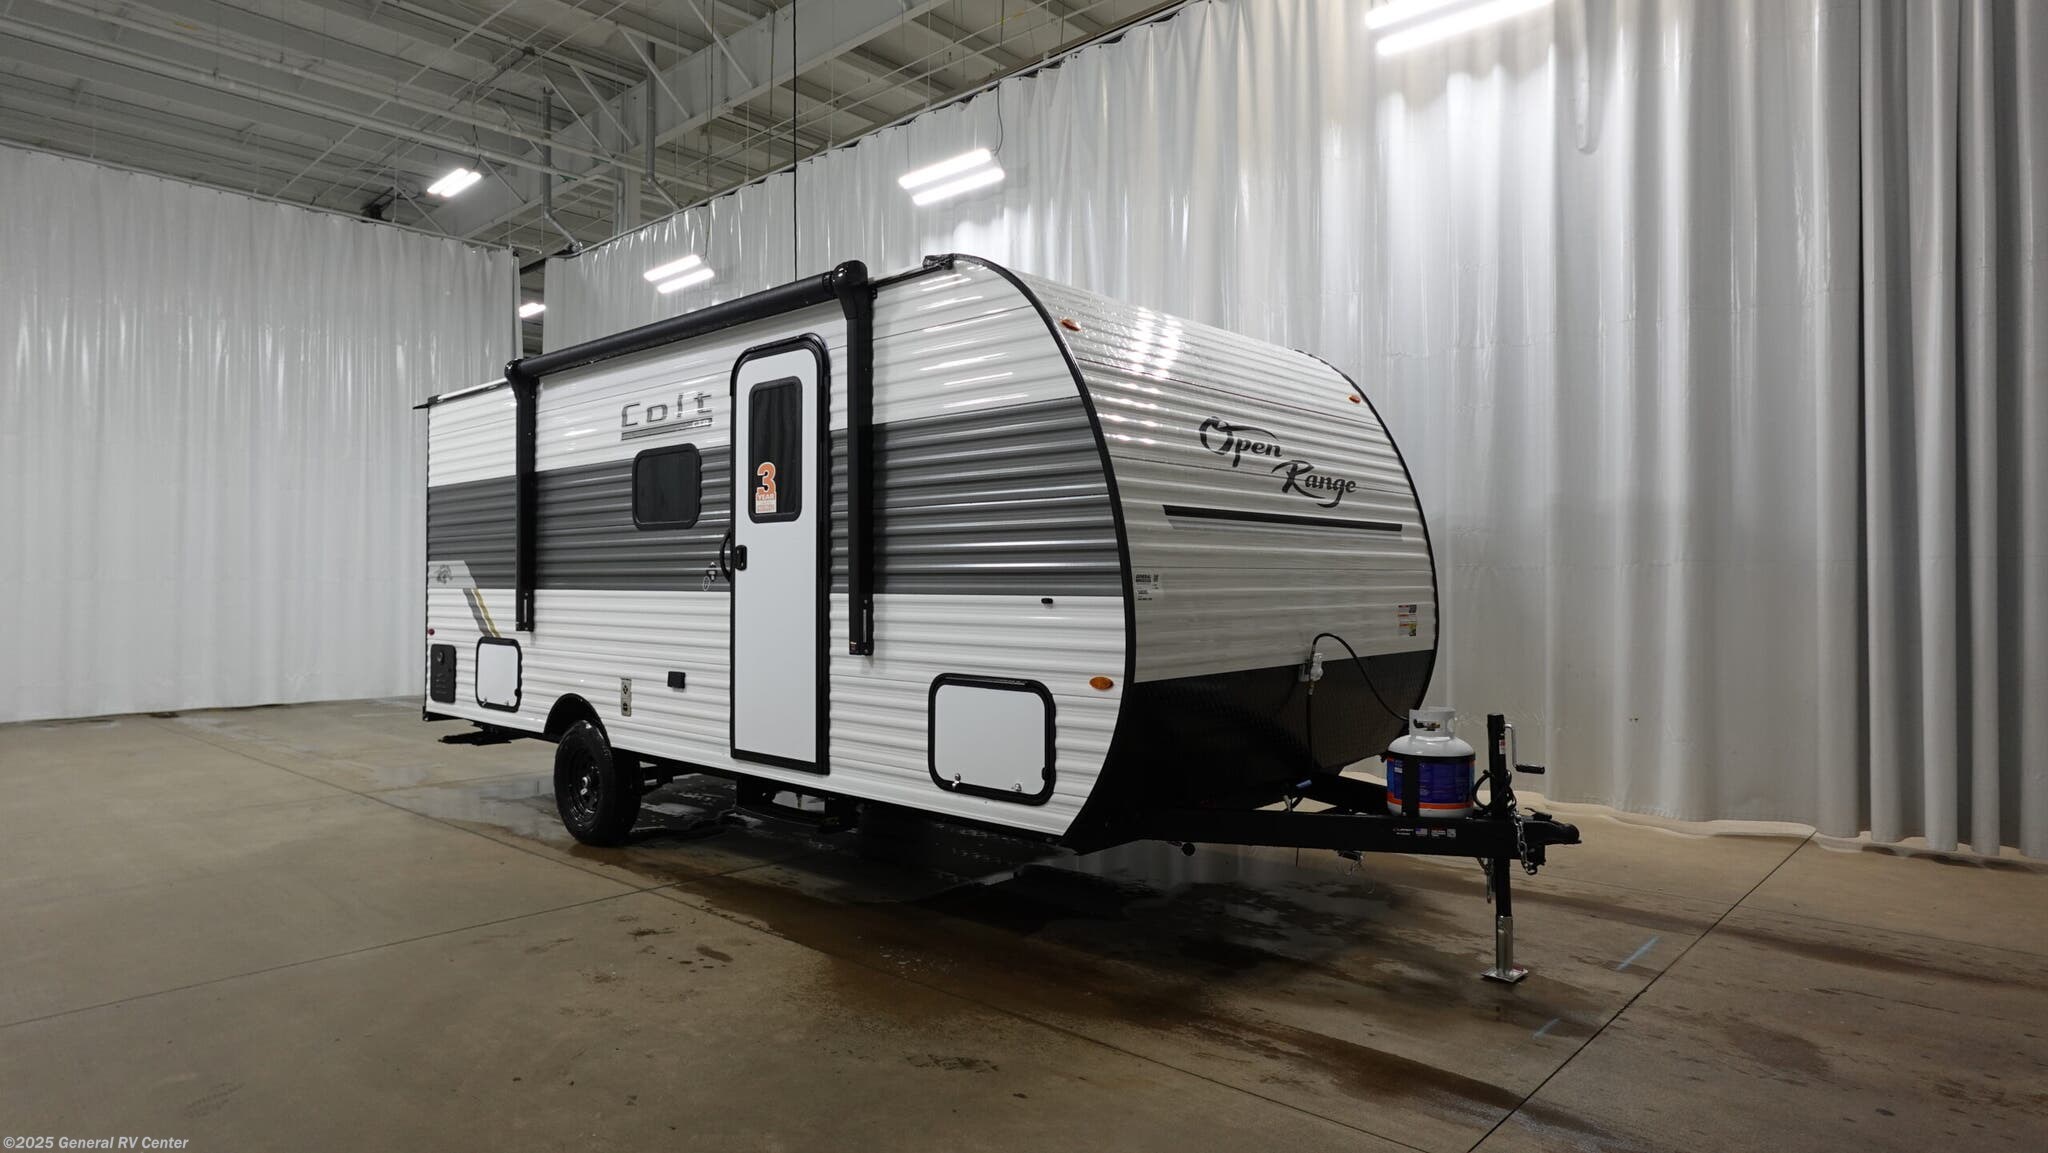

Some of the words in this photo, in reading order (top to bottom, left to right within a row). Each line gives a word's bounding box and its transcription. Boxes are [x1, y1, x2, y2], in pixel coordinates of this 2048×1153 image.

[621, 392, 712, 427] Colt
[1199, 416, 1282, 467] Open
[757, 462, 776, 495] 3
[1271, 460, 1357, 508] Range
